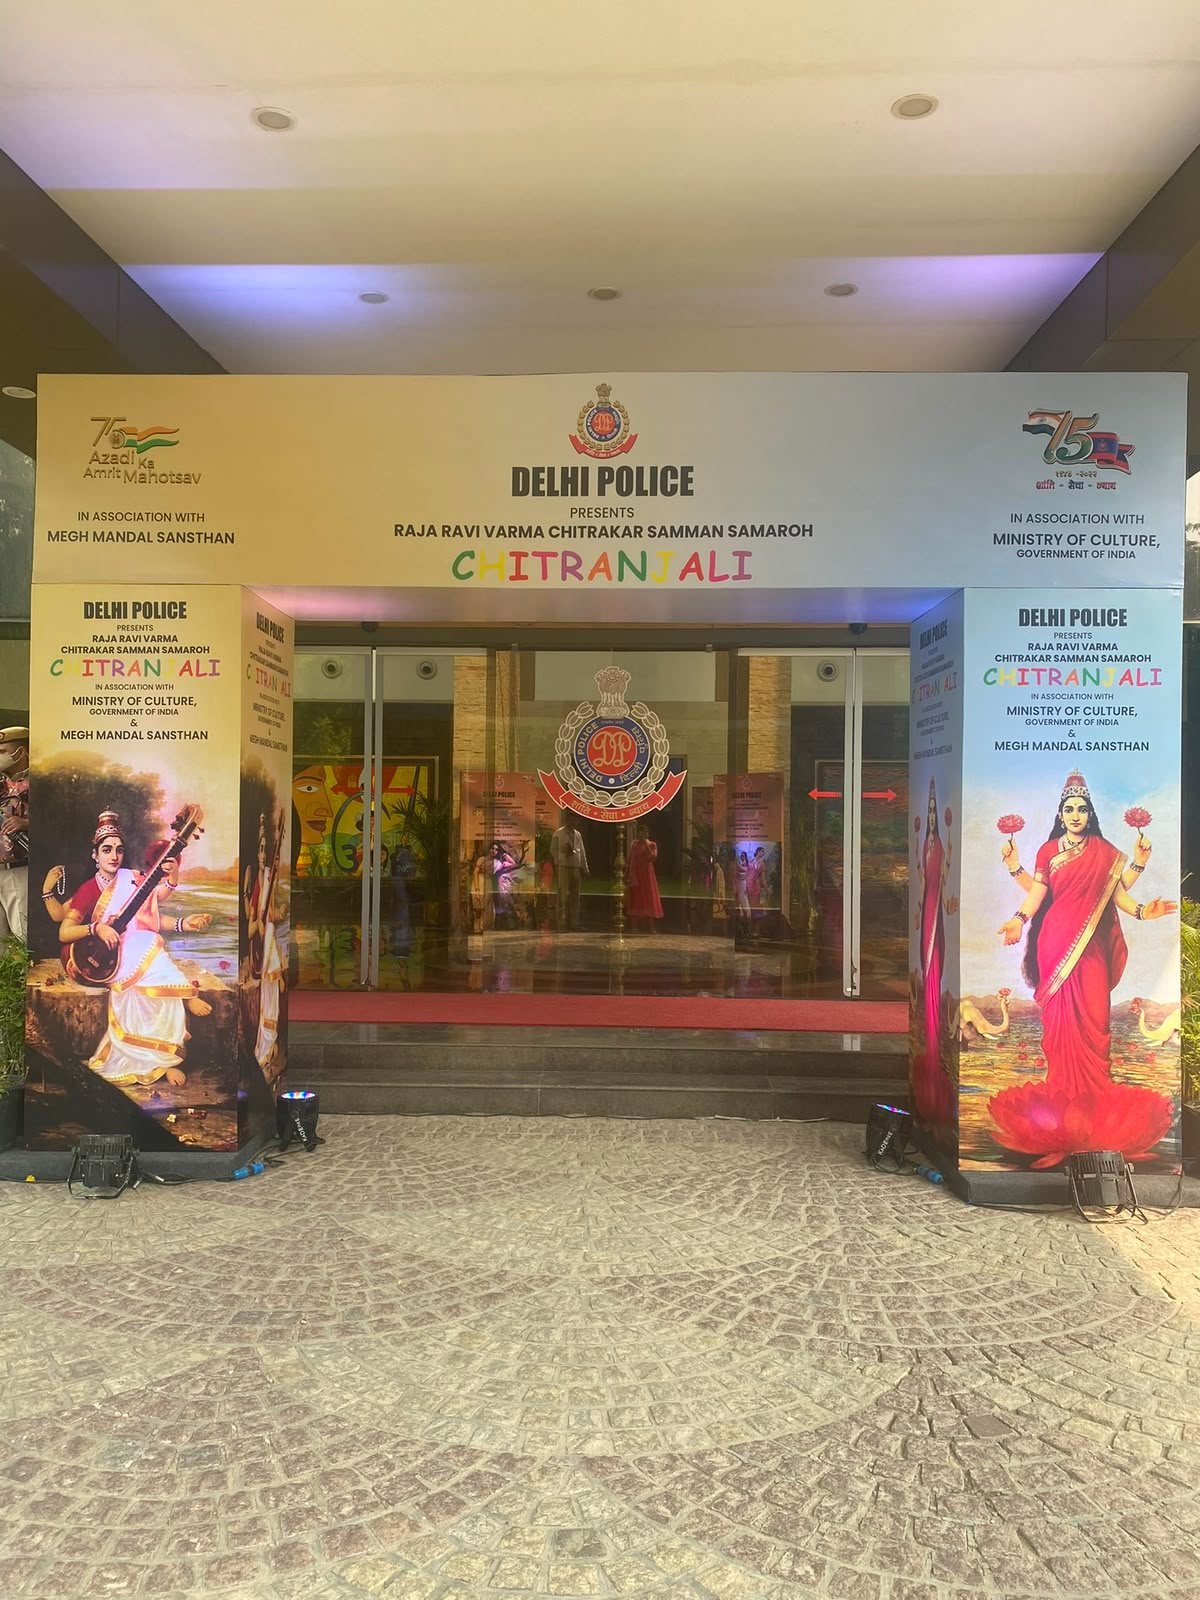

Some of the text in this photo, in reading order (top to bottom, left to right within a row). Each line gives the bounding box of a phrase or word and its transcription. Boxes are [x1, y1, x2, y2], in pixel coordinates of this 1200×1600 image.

[89, 450, 154, 469] Azadi Ka
[83, 467, 201, 484] Amrit Mahotsav
[512, 465, 694, 497] DELHI POLICE
[78, 512, 205, 522] IN ASSOCIATION WITH
[570, 507, 634, 519] PRESENTS
[1010, 513, 1144, 524] IN ASSOCIATION WITH
[48, 531, 235, 544] MEGH MANDAL SANSTHAN
[394, 524, 813, 539] RAJA RAVI VARMA CHITRAKAR SAMMAN SAMAROH
[993, 533, 1160, 548] MINISTRY OF CULTURE,
[1016, 549, 1136, 559] GOVERNMENT OF INDIA
[452, 550, 753, 582] CHITRANJALI
[83, 601, 187, 619] DELHI POLICE
[1019, 608, 1128, 627] DELHI POLICE
[257, 612, 284, 643] DELHI POLICE
[92, 635, 178, 643] RAJA RAVI VARMA
[61, 646, 210, 654] CHITRAKAR SAMMAN SAMAROH
[1028, 642, 1118, 651] RAJA RAVI VARMA
[994, 654, 1151, 662] CHITRAKAR SAMMAN SAMAROH
[247, 664, 291, 697] CITRANALI
[983, 667, 1162, 688] CHITRANJALI
[72, 696, 197, 708] MINISTRY OF CULTURE,
[89, 708, 179, 716] GOVERNMENT OF INDIA
[1007, 706, 1138, 718] MINISTRY OF CULTURE,
[130, 719, 138, 727] &
[61, 730, 208, 740] MEGH MANDAL SANSTHAN
[1068, 729, 1076, 737] &
[994, 741, 1149, 751] MEGH MANDAL SANSTHAN
[578, 722, 603, 783] DELHI POLICE
[600, 811, 618, 820] सेवा
